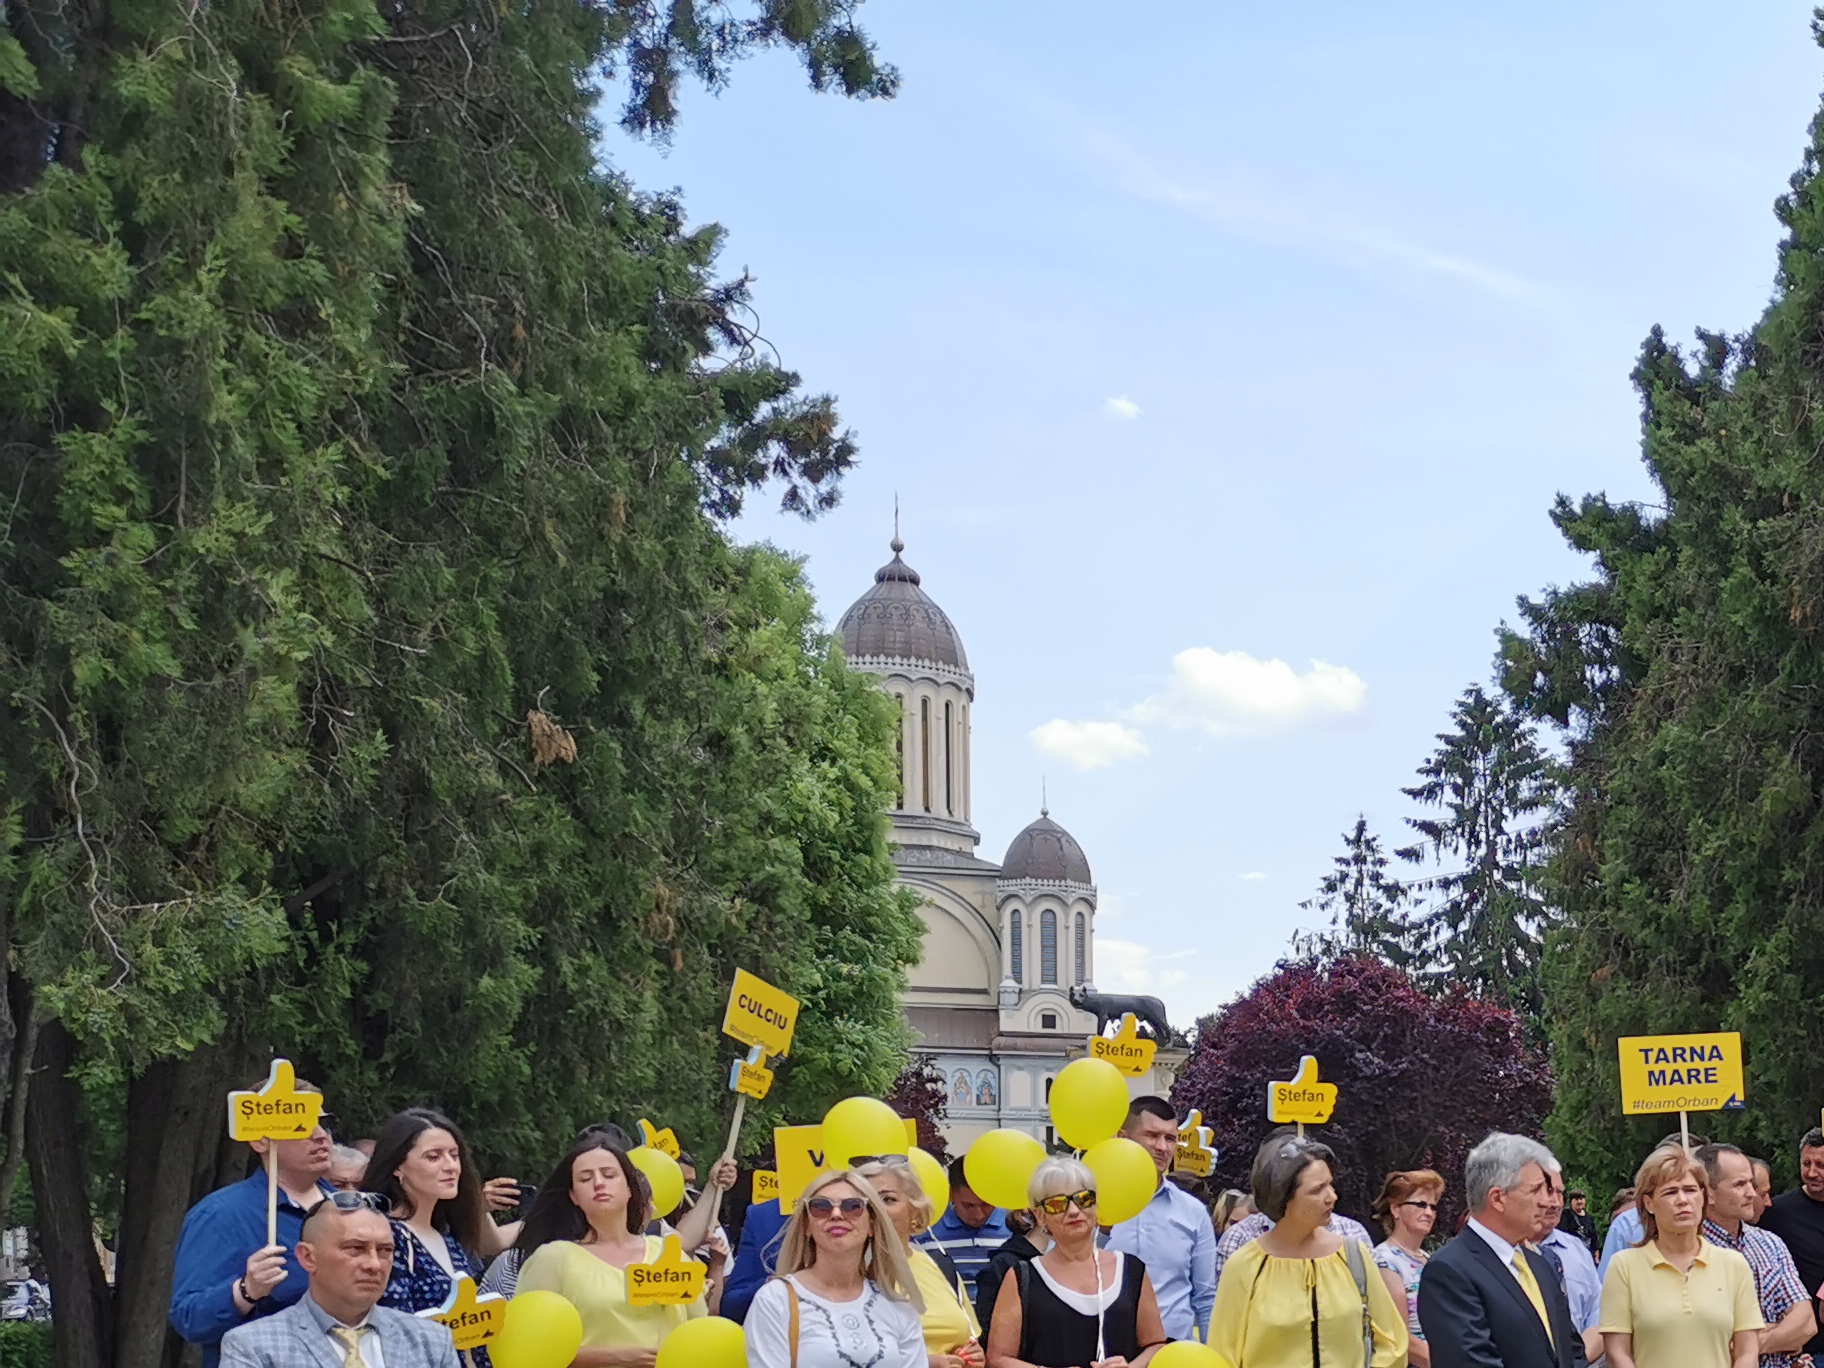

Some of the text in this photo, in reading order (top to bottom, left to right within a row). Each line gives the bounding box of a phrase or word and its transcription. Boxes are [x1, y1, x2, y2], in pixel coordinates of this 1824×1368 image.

[738, 994, 788, 1030] CULCIU
[1638, 1045, 1725, 1065] TARNA
[1647, 1067, 1719, 1088] MARE
[241, 1099, 306, 1120] Ștefan
[1632, 1096, 1719, 1111] #teamOrban
[633, 1268, 692, 1288] Ștefan
